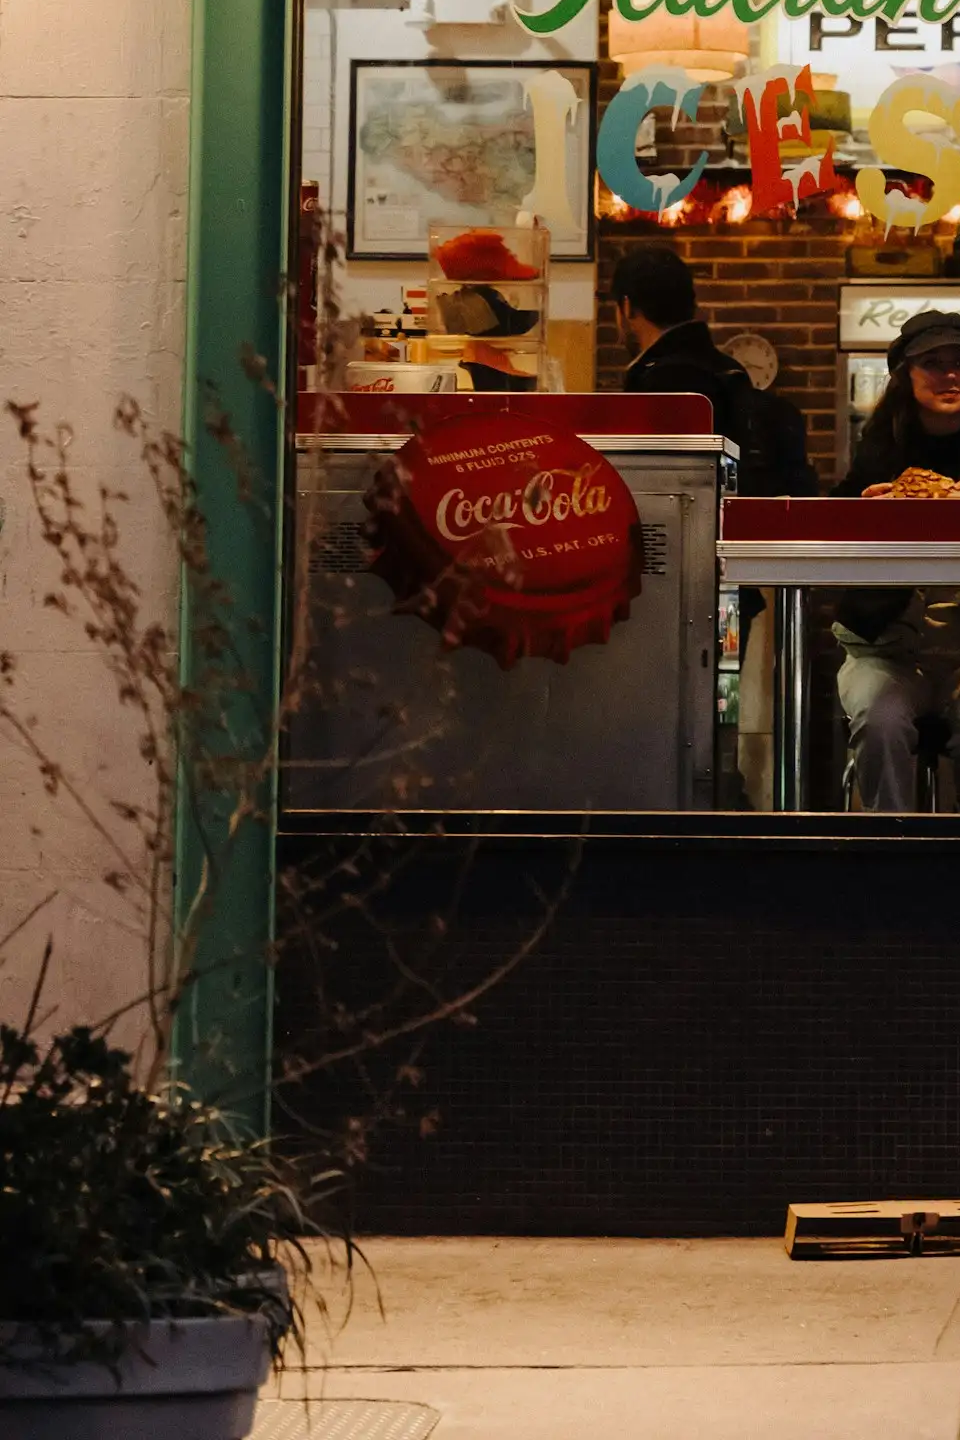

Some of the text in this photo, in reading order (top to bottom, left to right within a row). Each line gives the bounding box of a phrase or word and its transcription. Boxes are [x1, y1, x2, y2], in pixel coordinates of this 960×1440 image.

[428, 434, 554, 466] MINIMUM CONTENTS
[455, 463, 465, 473] 6
[467, 456, 506, 472] FLUID
[436, 462, 612, 541] Coca-Cola
[521, 546, 552, 560] U.S.
[553, 538, 585, 554] PAT.
[587, 532, 620, 548] OFF.
